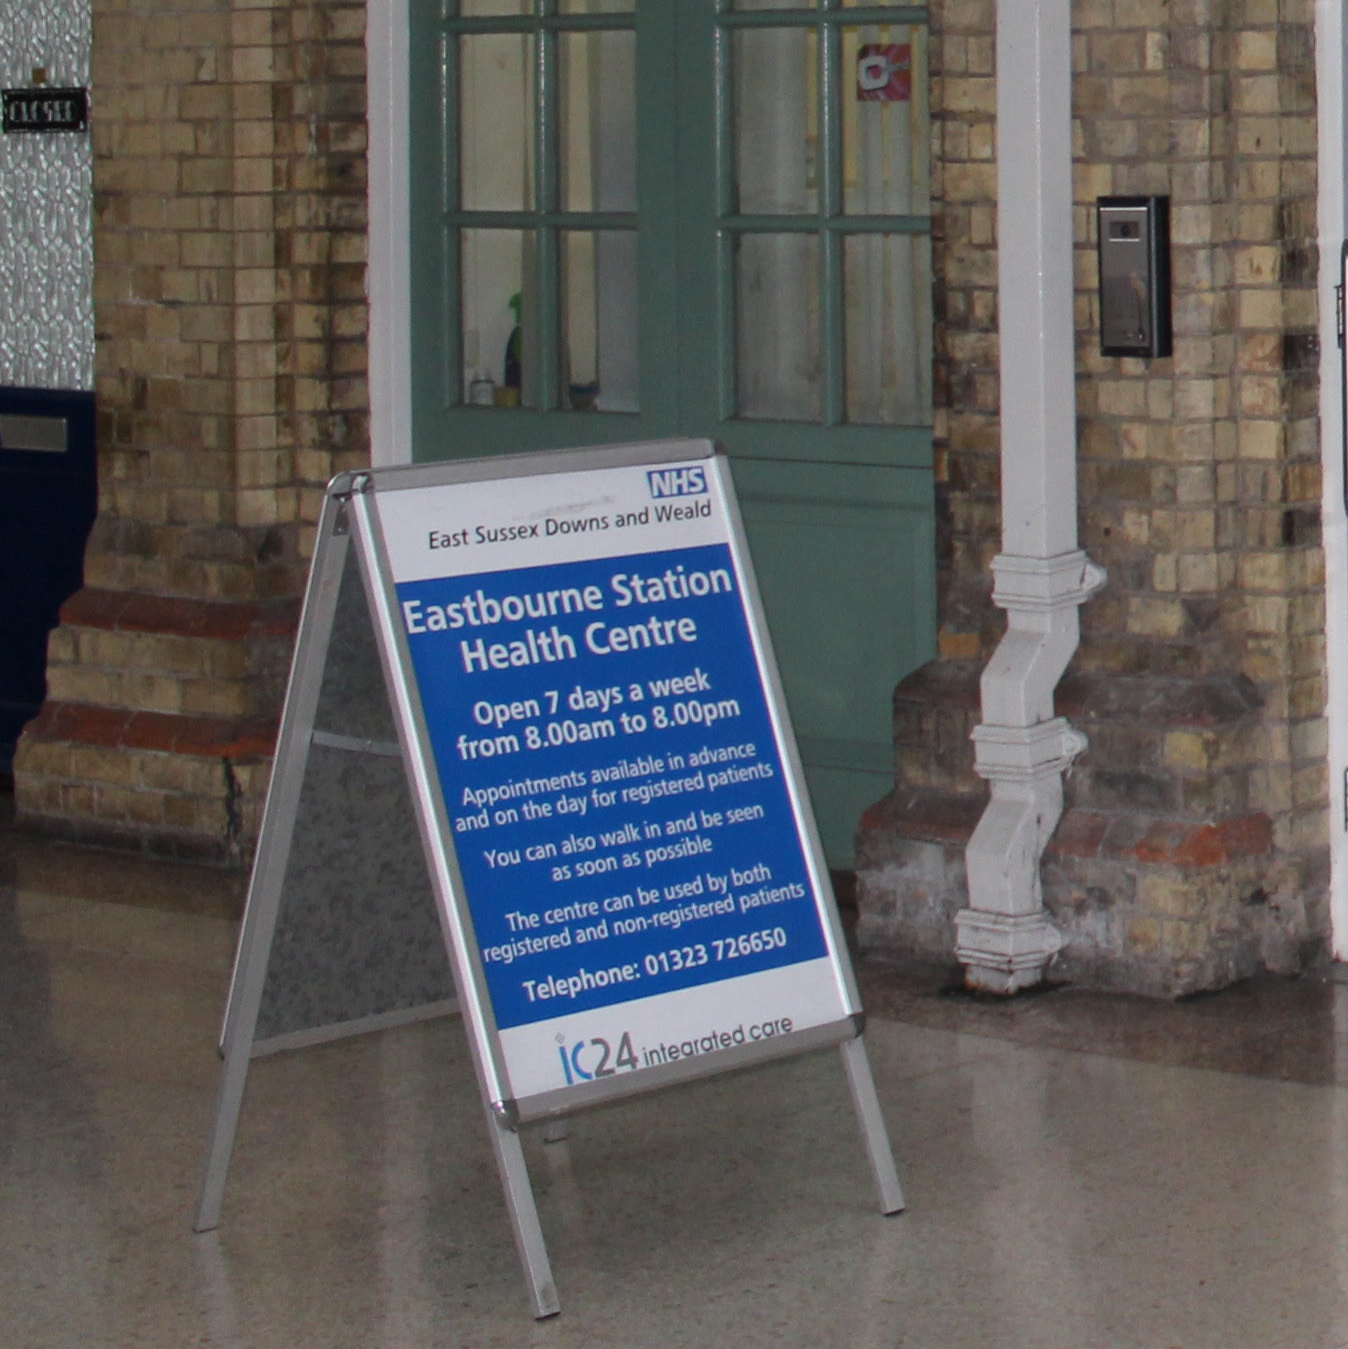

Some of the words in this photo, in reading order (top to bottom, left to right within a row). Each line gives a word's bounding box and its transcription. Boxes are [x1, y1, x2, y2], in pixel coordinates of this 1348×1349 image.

[650, 466, 704, 497] NHS
[428, 529, 468, 550] East
[474, 524, 538, 544] Sussex
[544, 516, 609, 536] Downs
[615, 506, 649, 528] and
[654, 499, 711, 523] Weald
[401, 585, 603, 634] Eastbourne
[610, 565, 732, 607] Station
[460, 626, 576, 673] Health
[584, 616, 697, 655] Centre
[473, 699, 540, 726] Open
[544, 690, 558, 714] 7
[567, 685, 623, 711] days
[628, 683, 644, 702] a
[647, 667, 711, 698] week
[456, 734, 519, 760] from
[523, 710, 615, 750] 8.00am
[619, 712, 647, 734] to
[651, 699, 740, 729] 8.00pm
[455, 808, 490, 832] and
[493, 808, 519, 825] on
[521, 800, 552, 820] the
[555, 794, 587, 814] day
[590, 788, 616, 807] for
[621, 770, 705, 803] registered
[706, 762, 773, 791] patients
[462, 770, 587, 807] Appointments
[590, 755, 664, 784] available
[667, 752, 685, 770] in
[688, 743, 756, 767] advance
[483, 849, 521, 868] You
[524, 843, 557, 861] can
[561, 833, 596, 855] also
[599, 823, 641, 847] walk
[643, 820, 661, 839] in
[665, 811, 698, 835] and
[699, 810, 723, 828] be
[725, 805, 764, 824] seen
[551, 865, 571, 882] as
[574, 856, 618, 877] soon
[621, 852, 641, 868] as
[644, 834, 712, 866] possible
[483, 926, 571, 963] registered
[575, 919, 608, 944] and
[612, 893, 735, 935] non-registered
[738, 883, 805, 913] patients
[504, 911, 540, 931] The
[543, 901, 599, 924] centre
[602, 894, 634, 912] can
[636, 887, 660, 906] be
[663, 875, 703, 900] used
[706, 873, 727, 893] by
[730, 862, 772, 887] both
[521, 963, 640, 1002] Telephone:
[644, 944, 708, 976] 01323
[711, 927, 786, 961] 726650
[749, 1017, 793, 1041] care
